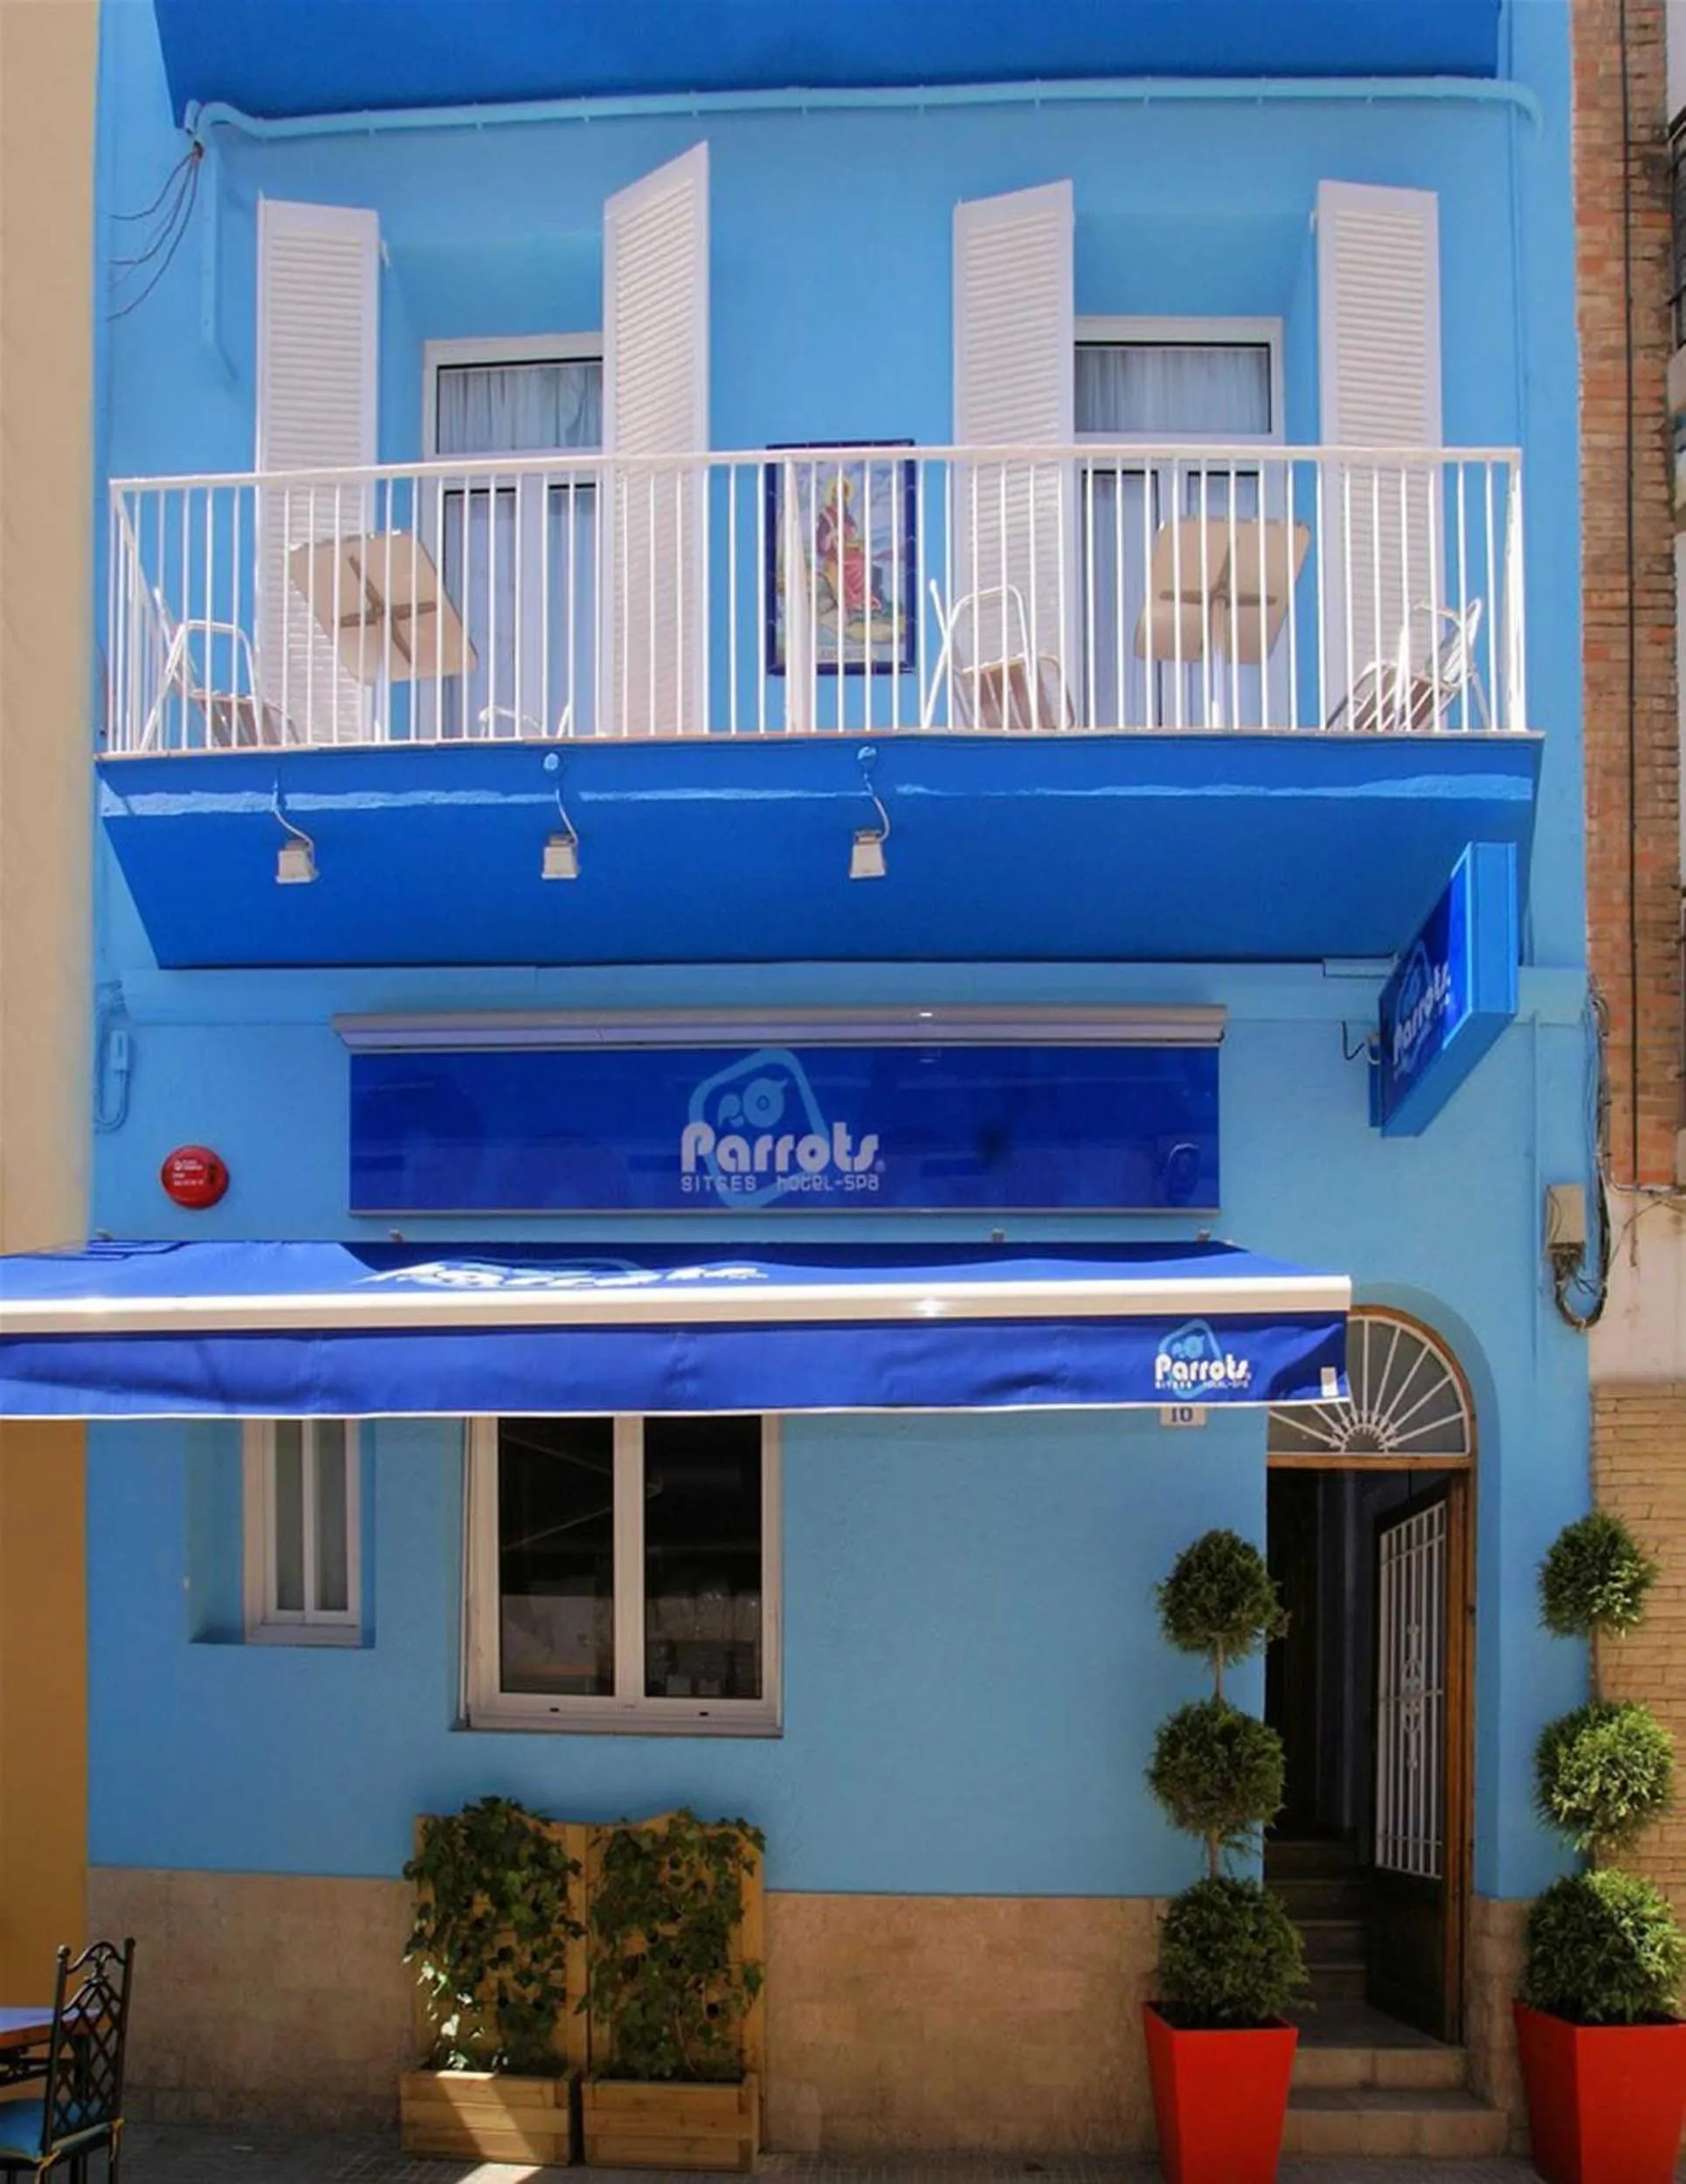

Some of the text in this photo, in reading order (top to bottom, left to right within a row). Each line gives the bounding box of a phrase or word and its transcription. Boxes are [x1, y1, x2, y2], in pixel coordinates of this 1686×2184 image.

[681, 1121, 878, 1172] Parrots
[1155, 1353, 1248, 1380] Parrots
[1171, 1406, 1193, 1422] 10
